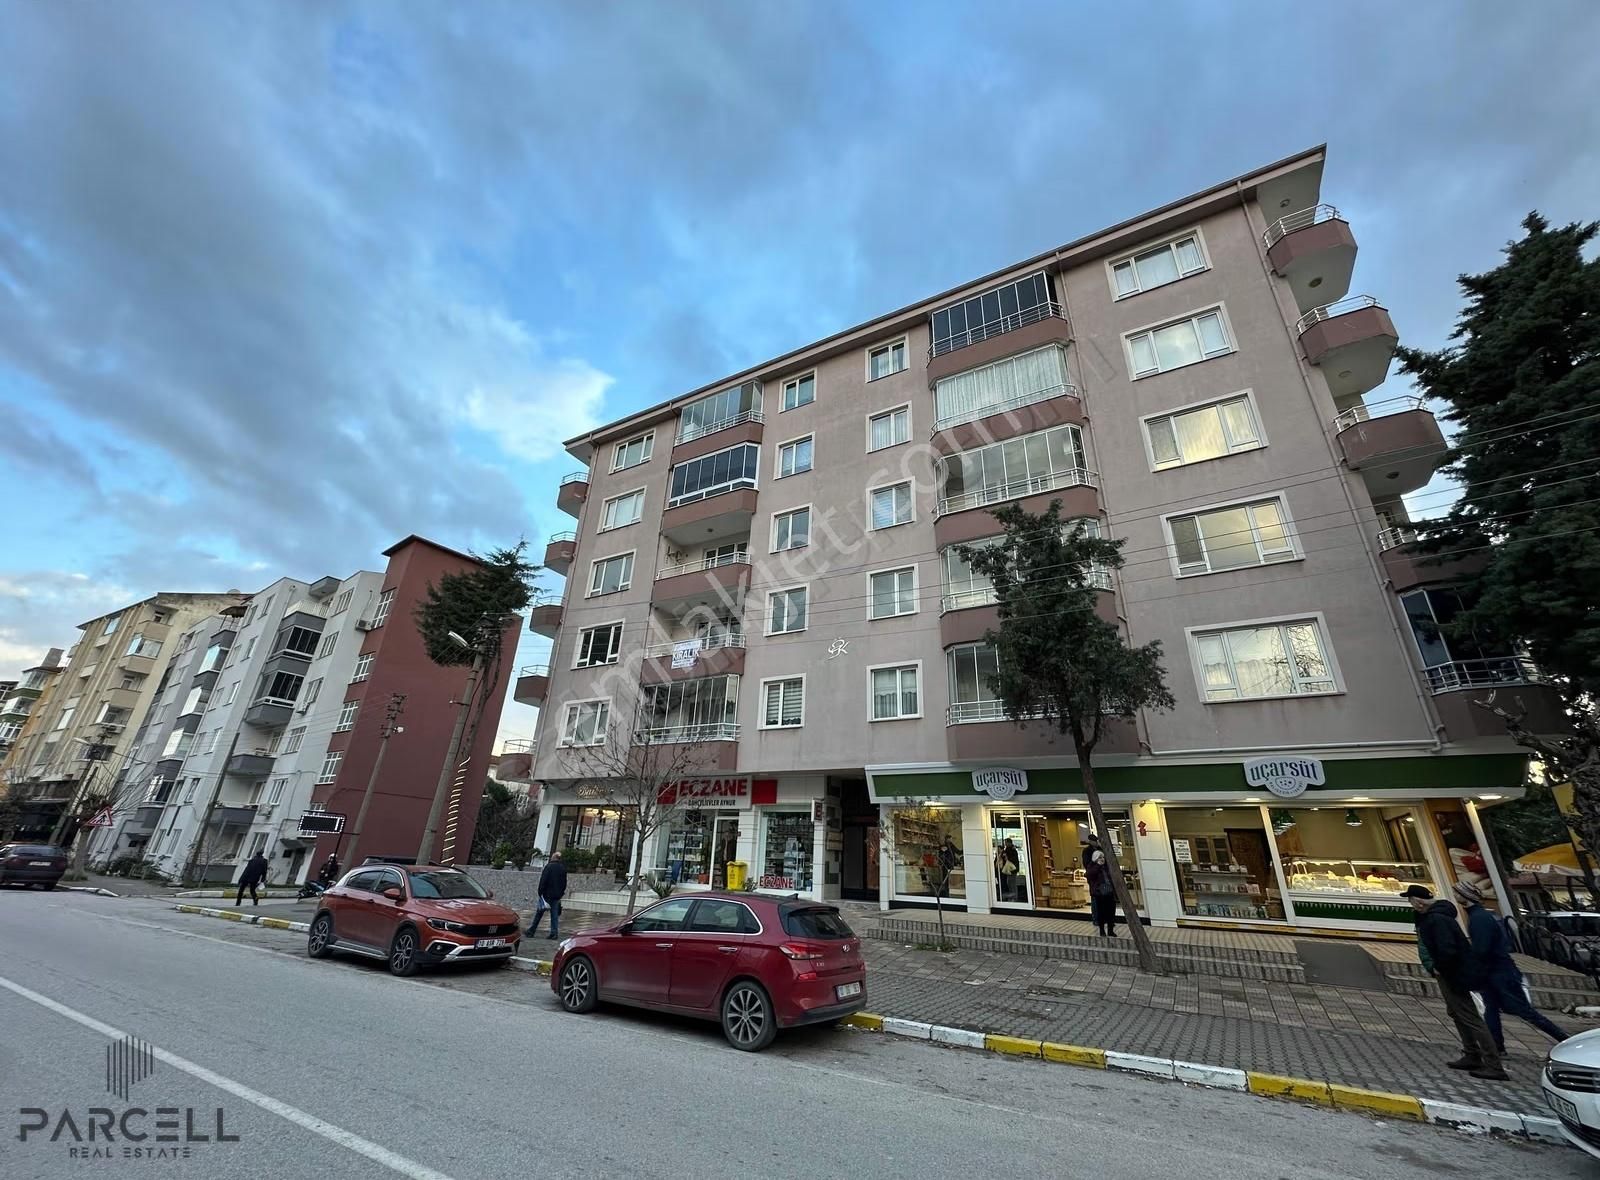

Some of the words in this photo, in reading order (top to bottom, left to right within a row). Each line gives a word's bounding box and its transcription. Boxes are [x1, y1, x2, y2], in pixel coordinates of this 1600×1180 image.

[976, 770, 1023, 788] uçarsüt
[1250, 760, 1319, 781] uçarsüt
[679, 779, 747, 797] ECZANE
[760, 875, 794, 889] ECZANE
